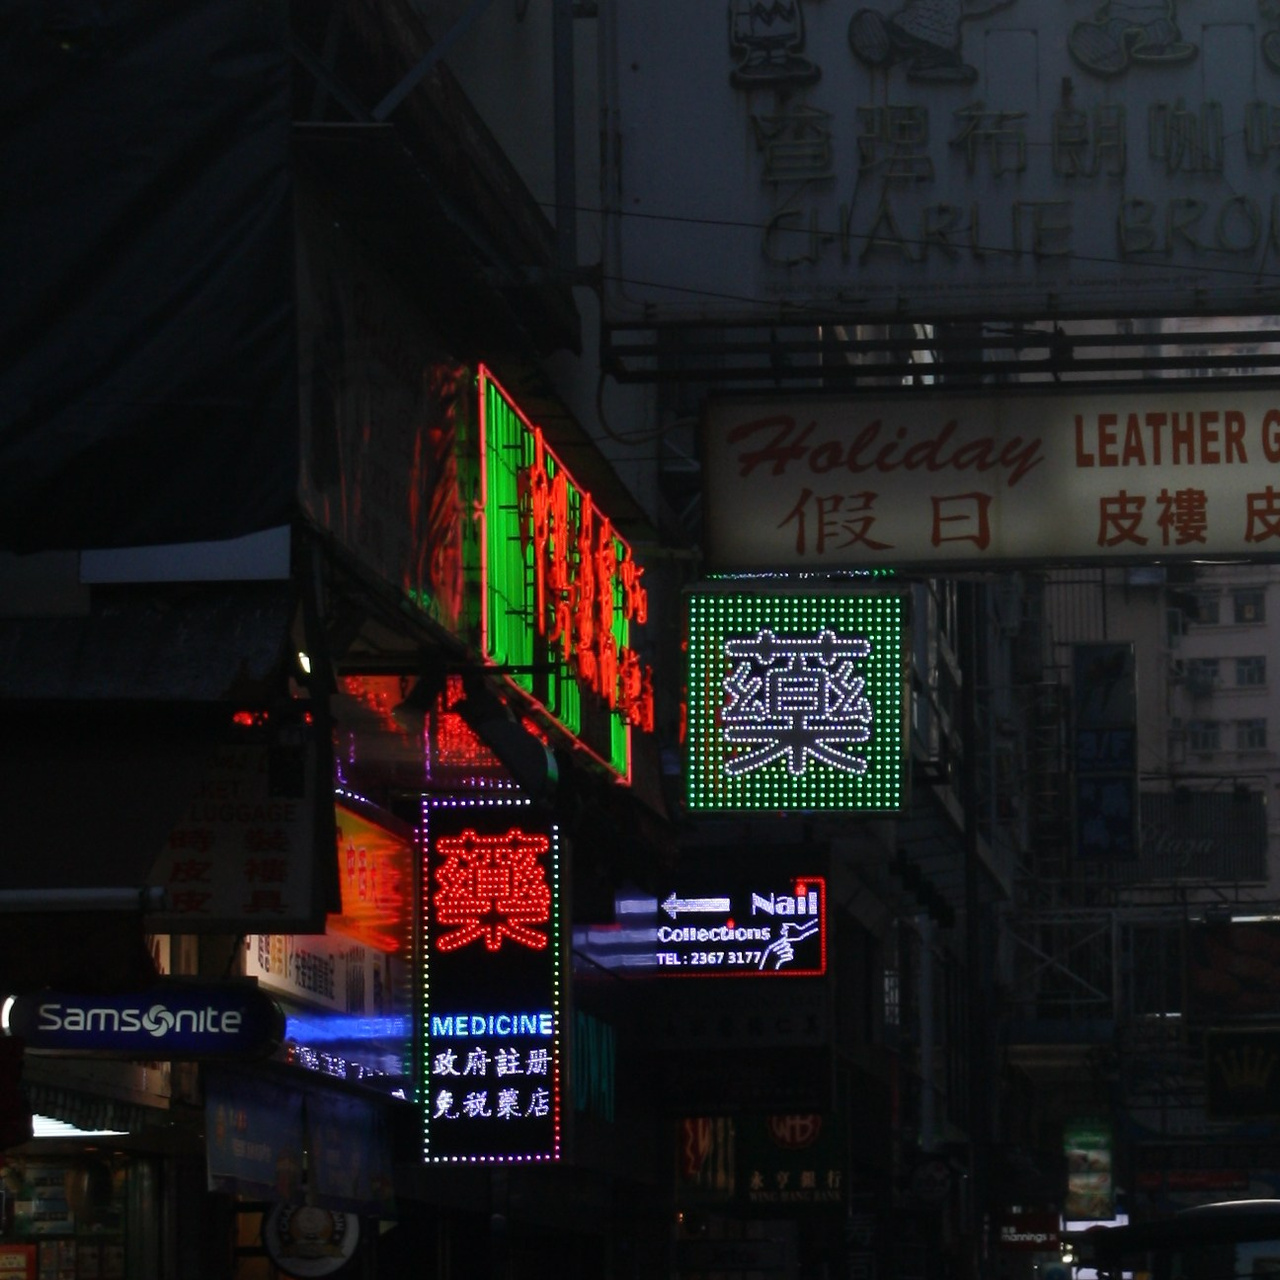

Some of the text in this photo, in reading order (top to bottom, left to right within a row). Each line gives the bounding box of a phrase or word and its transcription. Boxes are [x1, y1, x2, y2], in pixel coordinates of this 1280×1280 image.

[761, 192, 1074, 265] CHARLIE
[727, 414, 1045, 486] Holiday
[1075, 408, 1246, 468] LEATHER
[778, 487, 992, 555] 假日
[721, 629, 873, 776] 藥
[190, 803, 297, 823] LUGGAGE
[433, 827, 551, 952] 藥
[752, 891, 818, 916] Nail
[657, 920, 771, 943] Collections
[690, 951, 725, 965] 2367
[728, 951, 762, 964] 3177
[38, 1004, 242, 1037] Samsonite
[432, 1014, 553, 1036] MEDICINE
